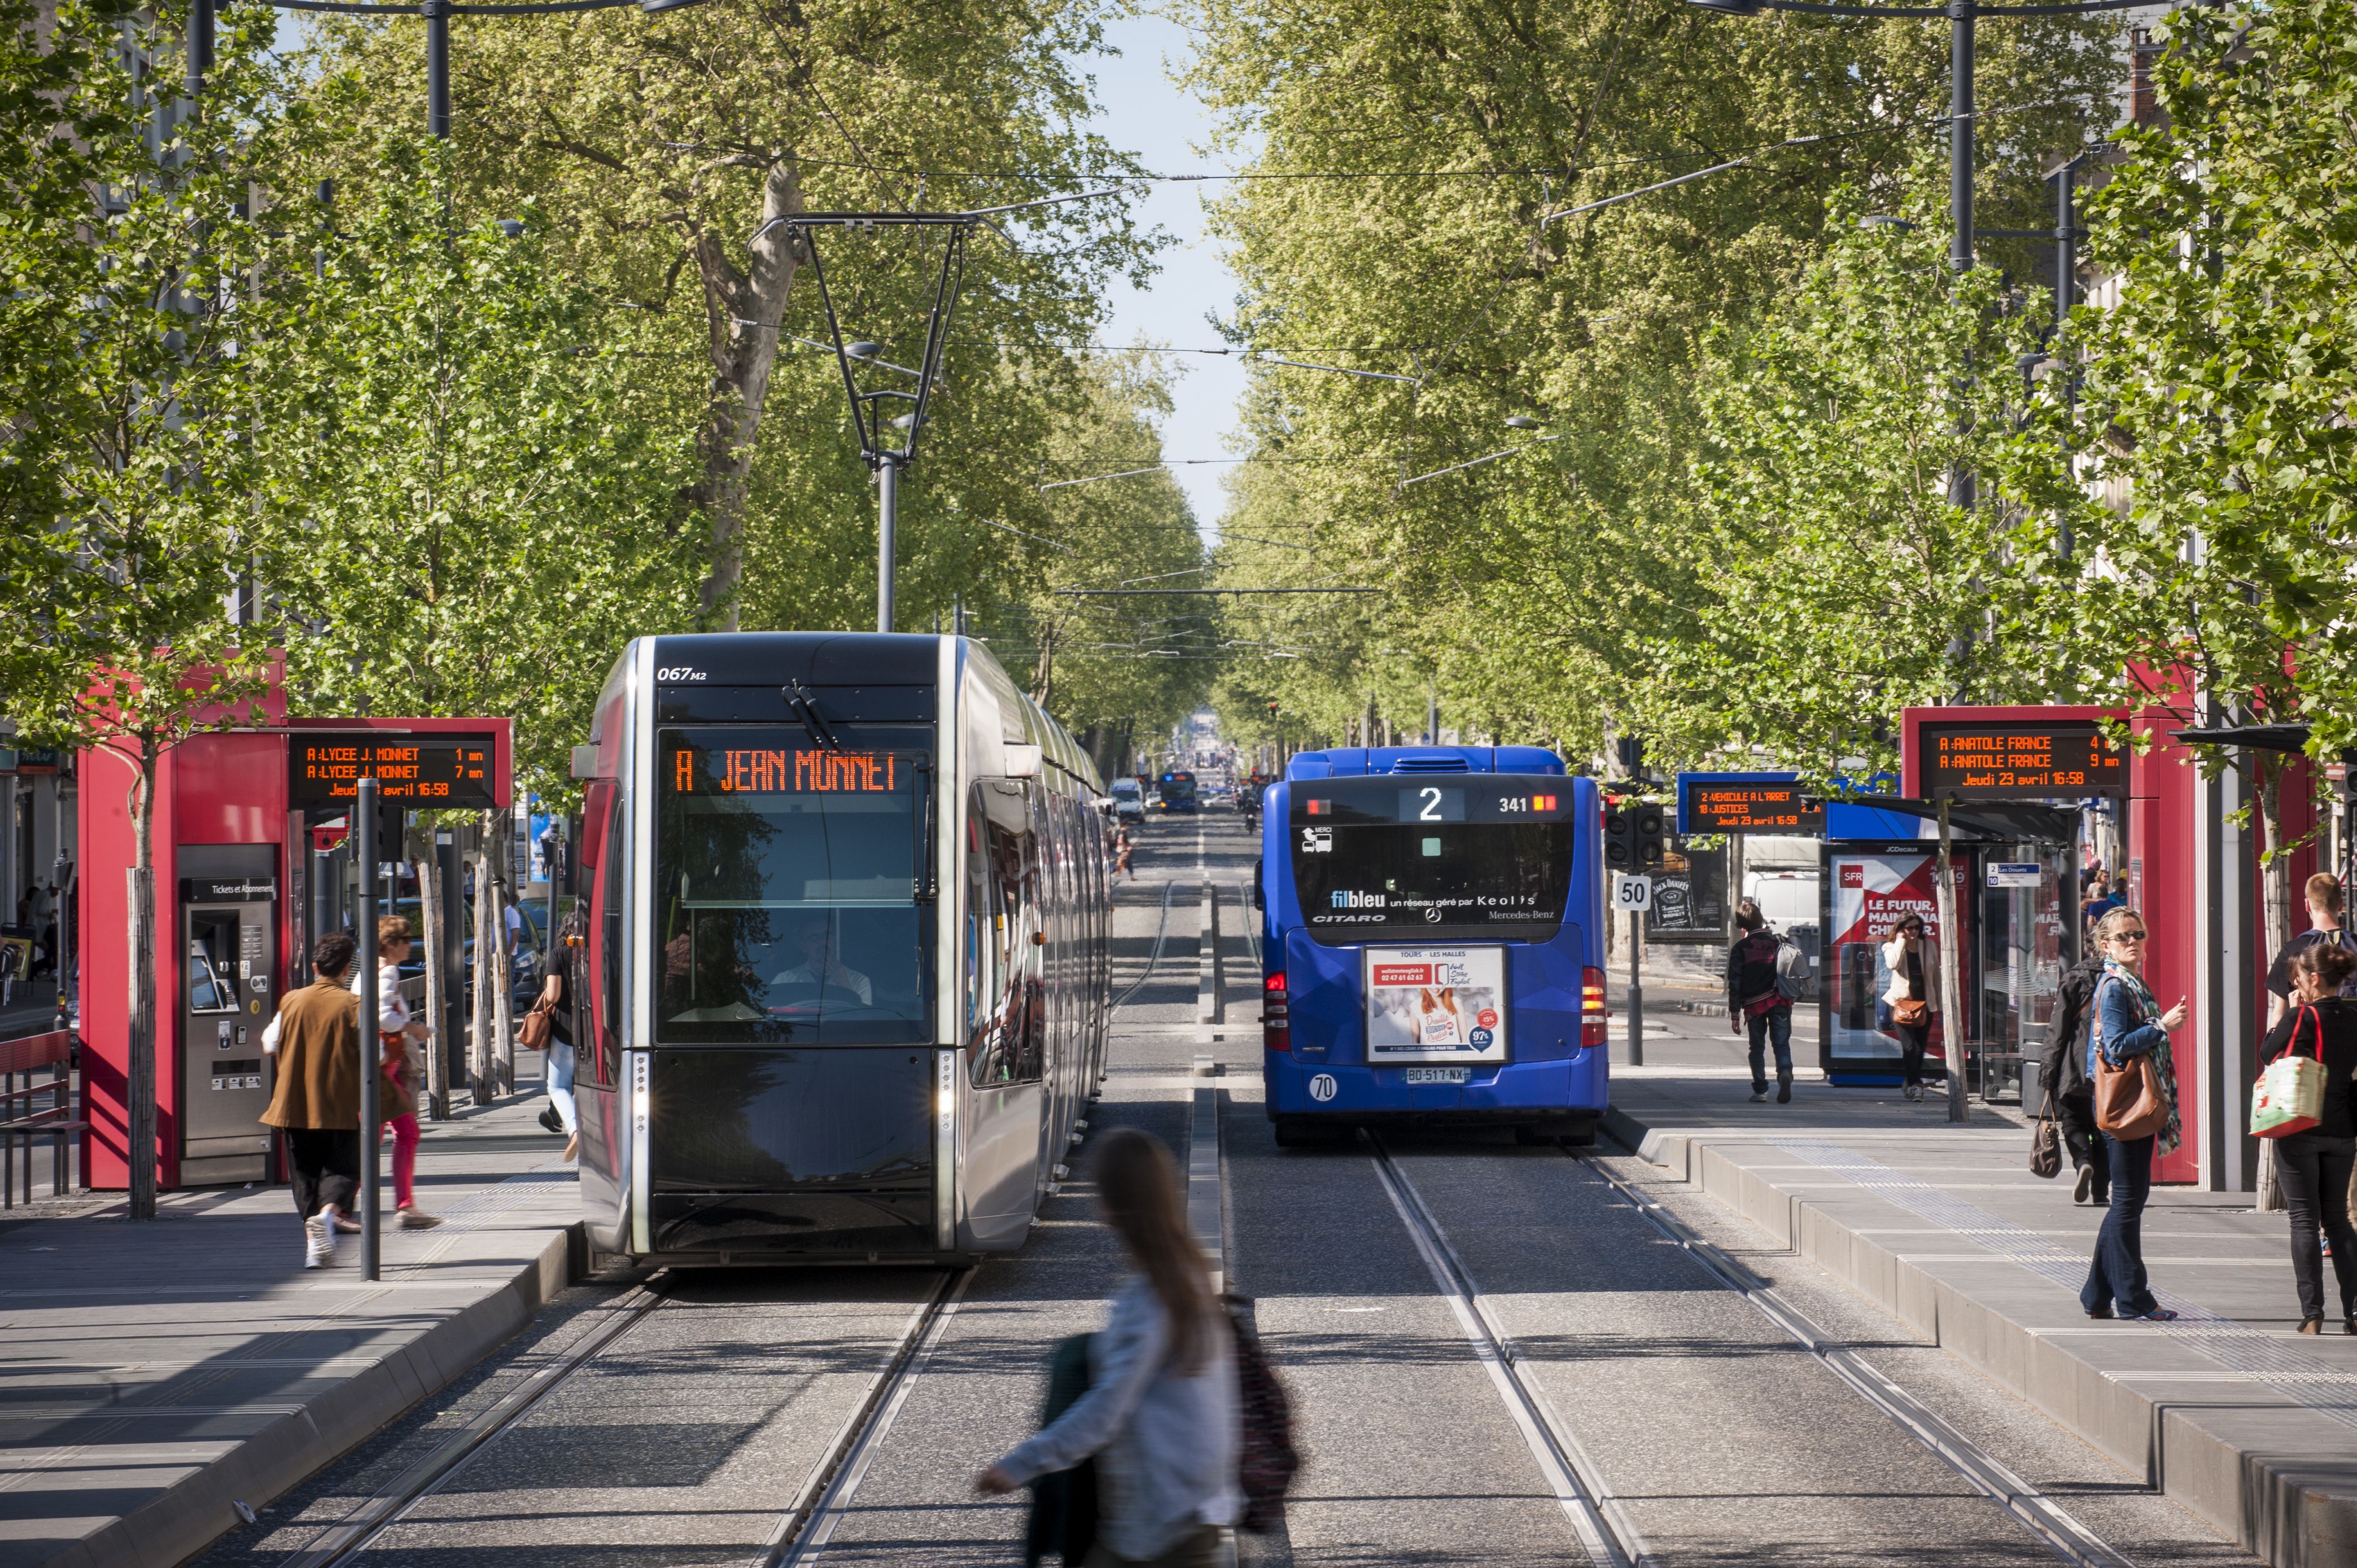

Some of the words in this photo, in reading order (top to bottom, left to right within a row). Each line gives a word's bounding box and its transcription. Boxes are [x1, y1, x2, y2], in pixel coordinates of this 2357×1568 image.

[1940, 737, 1948, 750] A
[2008, 737, 2051, 750] FRANCE
[2091, 735, 2098, 748] 4
[308, 748, 315, 760] A
[361, 748, 373, 760] J.
[377, 748, 419, 760] MONNET
[456, 748, 462, 760] 1
[1940, 755, 1948, 768] A
[2008, 754, 2051, 767] FRANCE
[2091, 754, 2098, 767] 9
[308, 765, 315, 778] A
[361, 765, 373, 778] J.
[377, 765, 419, 778] MONNET
[456, 765, 463, 778] 7
[676, 751, 692, 791] A
[721, 751, 785, 791] JEAN
[795, 751, 894, 790] MONNET
[1962, 772, 1995, 786] Jeudi
[1999, 772, 2014, 785] 23
[2018, 772, 2048, 785] avril
[2052, 772, 2084, 785] 16:58
[330, 783, 357, 795] Jeud
[384, 783, 413, 795] avril
[417, 783, 449, 795] 16:58
[1702, 792, 1708, 801] 2
[1751, 792, 1756, 801] A
[1419, 787, 1442, 820] 2
[1499, 798, 1527, 812] 341
[1699, 804, 1708, 813] 10
[1717, 816, 1738, 825] Jeudi
[1741, 816, 1751, 825] 23
[1753, 816, 1774, 825] avril
[1777, 816, 1798, 825] 16:58
[1844, 872, 1862, 881] SFR
[212, 885, 234, 894] Tickets
[1621, 883, 1645, 904] 50
[1331, 890, 1385, 908] filbleu
[1436, 899, 1456, 908] géré
[1477, 896, 1535, 905] Keolis
[1868, 900, 1884, 910] LE
[1887, 900, 1935, 912] FUTUR,
[1489, 910, 1554, 920] Mercedes-Benz
[1472, 1031, 1489, 1040] 97%
[1409, 1070, 1463, 1080] BD-517-NX
[1315, 1077, 1332, 1098] 70
